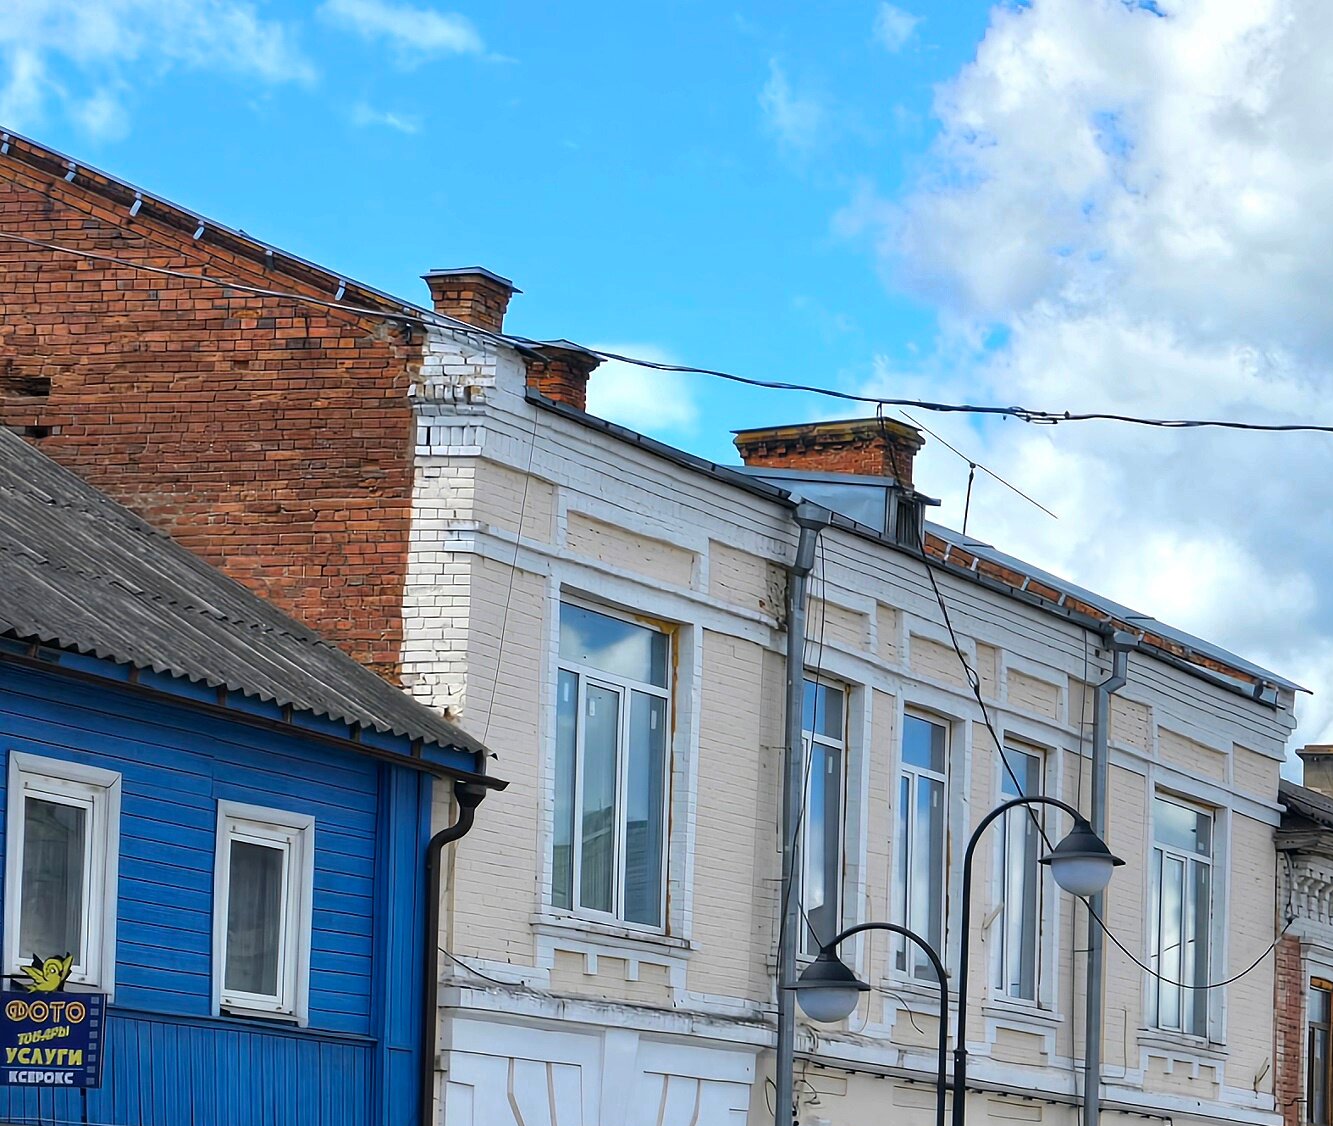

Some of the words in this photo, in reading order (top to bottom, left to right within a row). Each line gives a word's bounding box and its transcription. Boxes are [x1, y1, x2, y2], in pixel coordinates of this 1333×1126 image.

[5, 1000, 86, 1024] ФОТО
[17, 1025, 70, 1045] ТОВАРЫ
[5, 1047, 83, 1066] УСЛУГИ
[8, 1070, 74, 1085] КСЕРОКС
